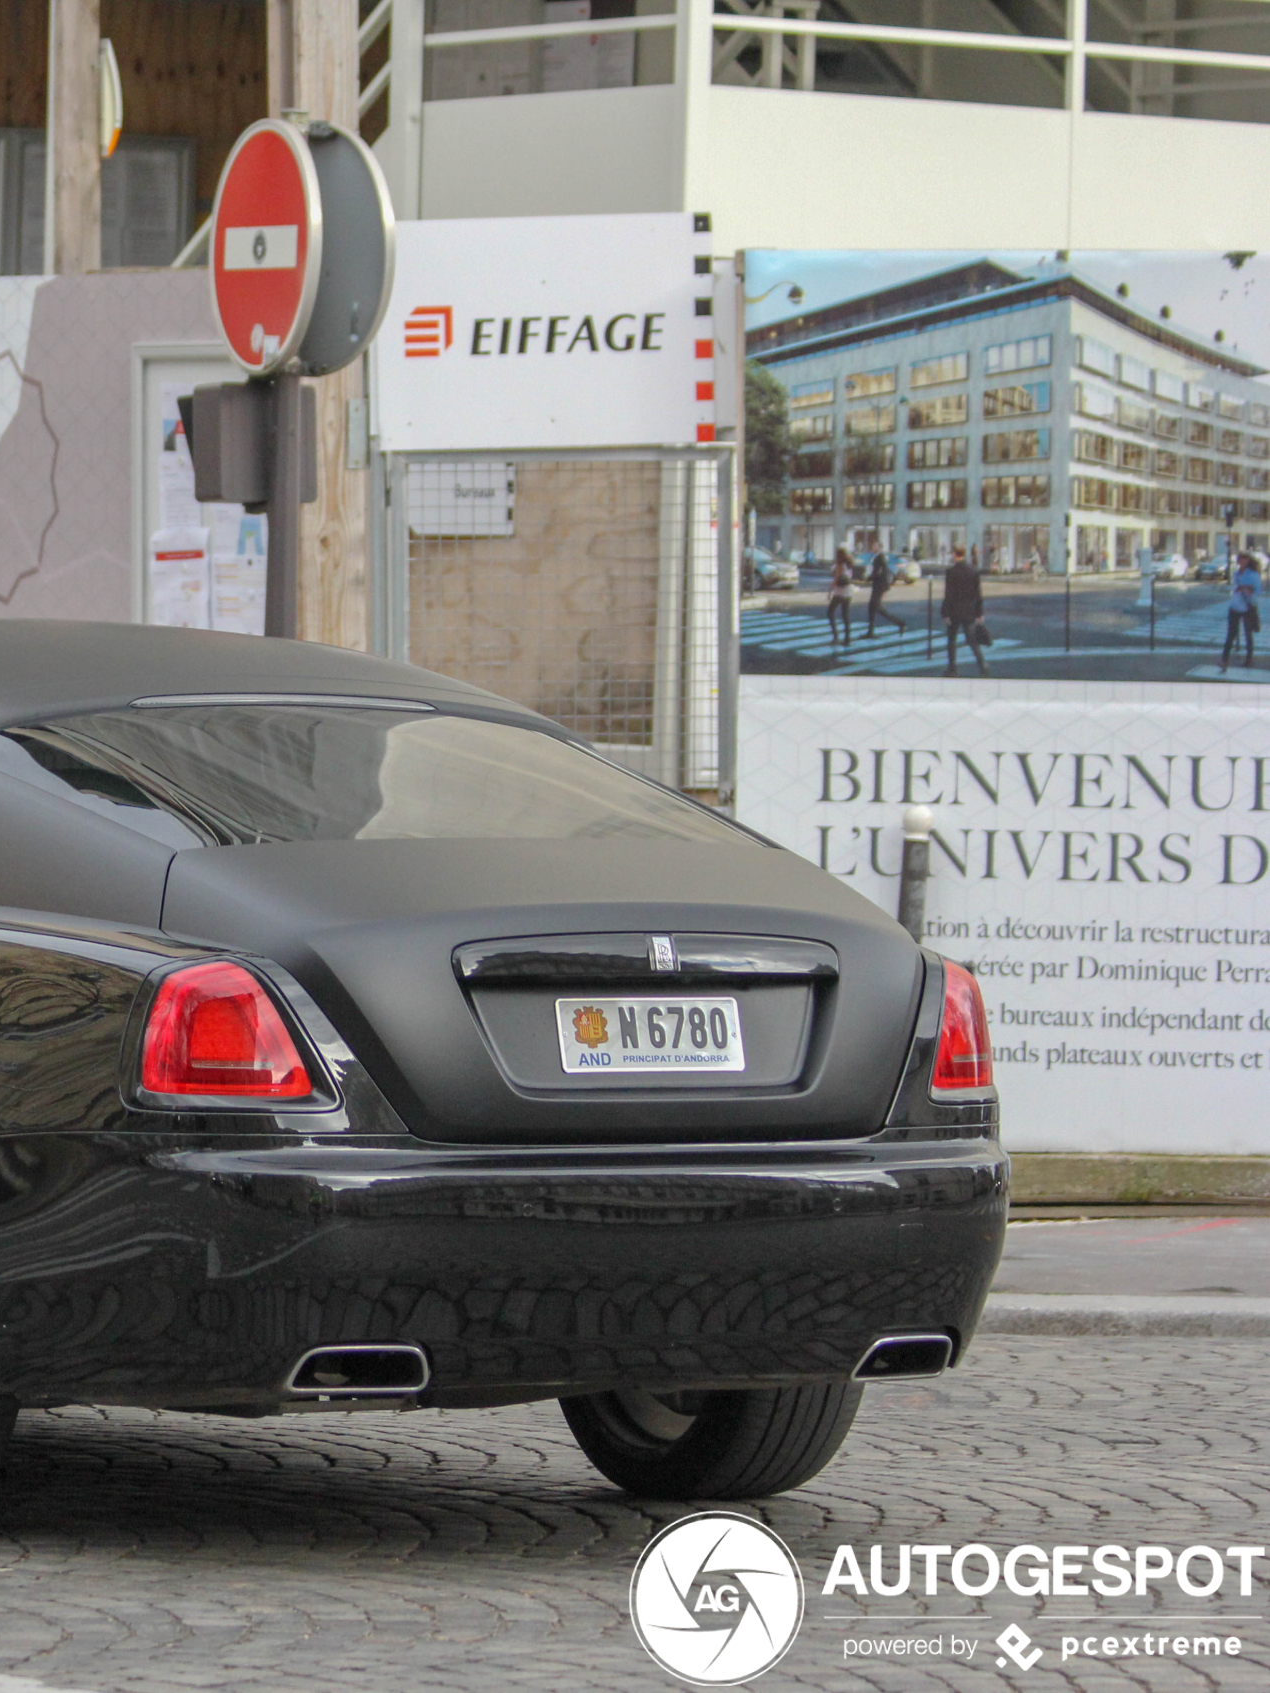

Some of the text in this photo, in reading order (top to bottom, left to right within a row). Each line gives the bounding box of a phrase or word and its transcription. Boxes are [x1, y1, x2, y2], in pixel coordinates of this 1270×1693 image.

[470, 312, 666, 356] EIFFAGE
[816, 826, 1194, 884] L'UNIVERS
[923, 916, 970, 939] tion
[977, 917, 990, 939] à
[996, 917, 1109, 942] découvrir
[1115, 920, 1134, 942] la
[976, 954, 1024, 977] érée
[1030, 960, 1070, 984] par
[1077, 956, 1208, 988] Dominique
[618, 1006, 728, 1049] N 6780
[1000, 1002, 1095, 1028] bureaux
[1101, 1006, 1244, 1036] indépendant
[579, 1052, 611, 1067] AND
[623, 1054, 730, 1064] PRINCIPAT D'ANDORRA
[1046, 1041, 1143, 1070] plateaux
[1149, 1050, 1235, 1069] ouverts
[1241, 1051, 1264, 1068] et
